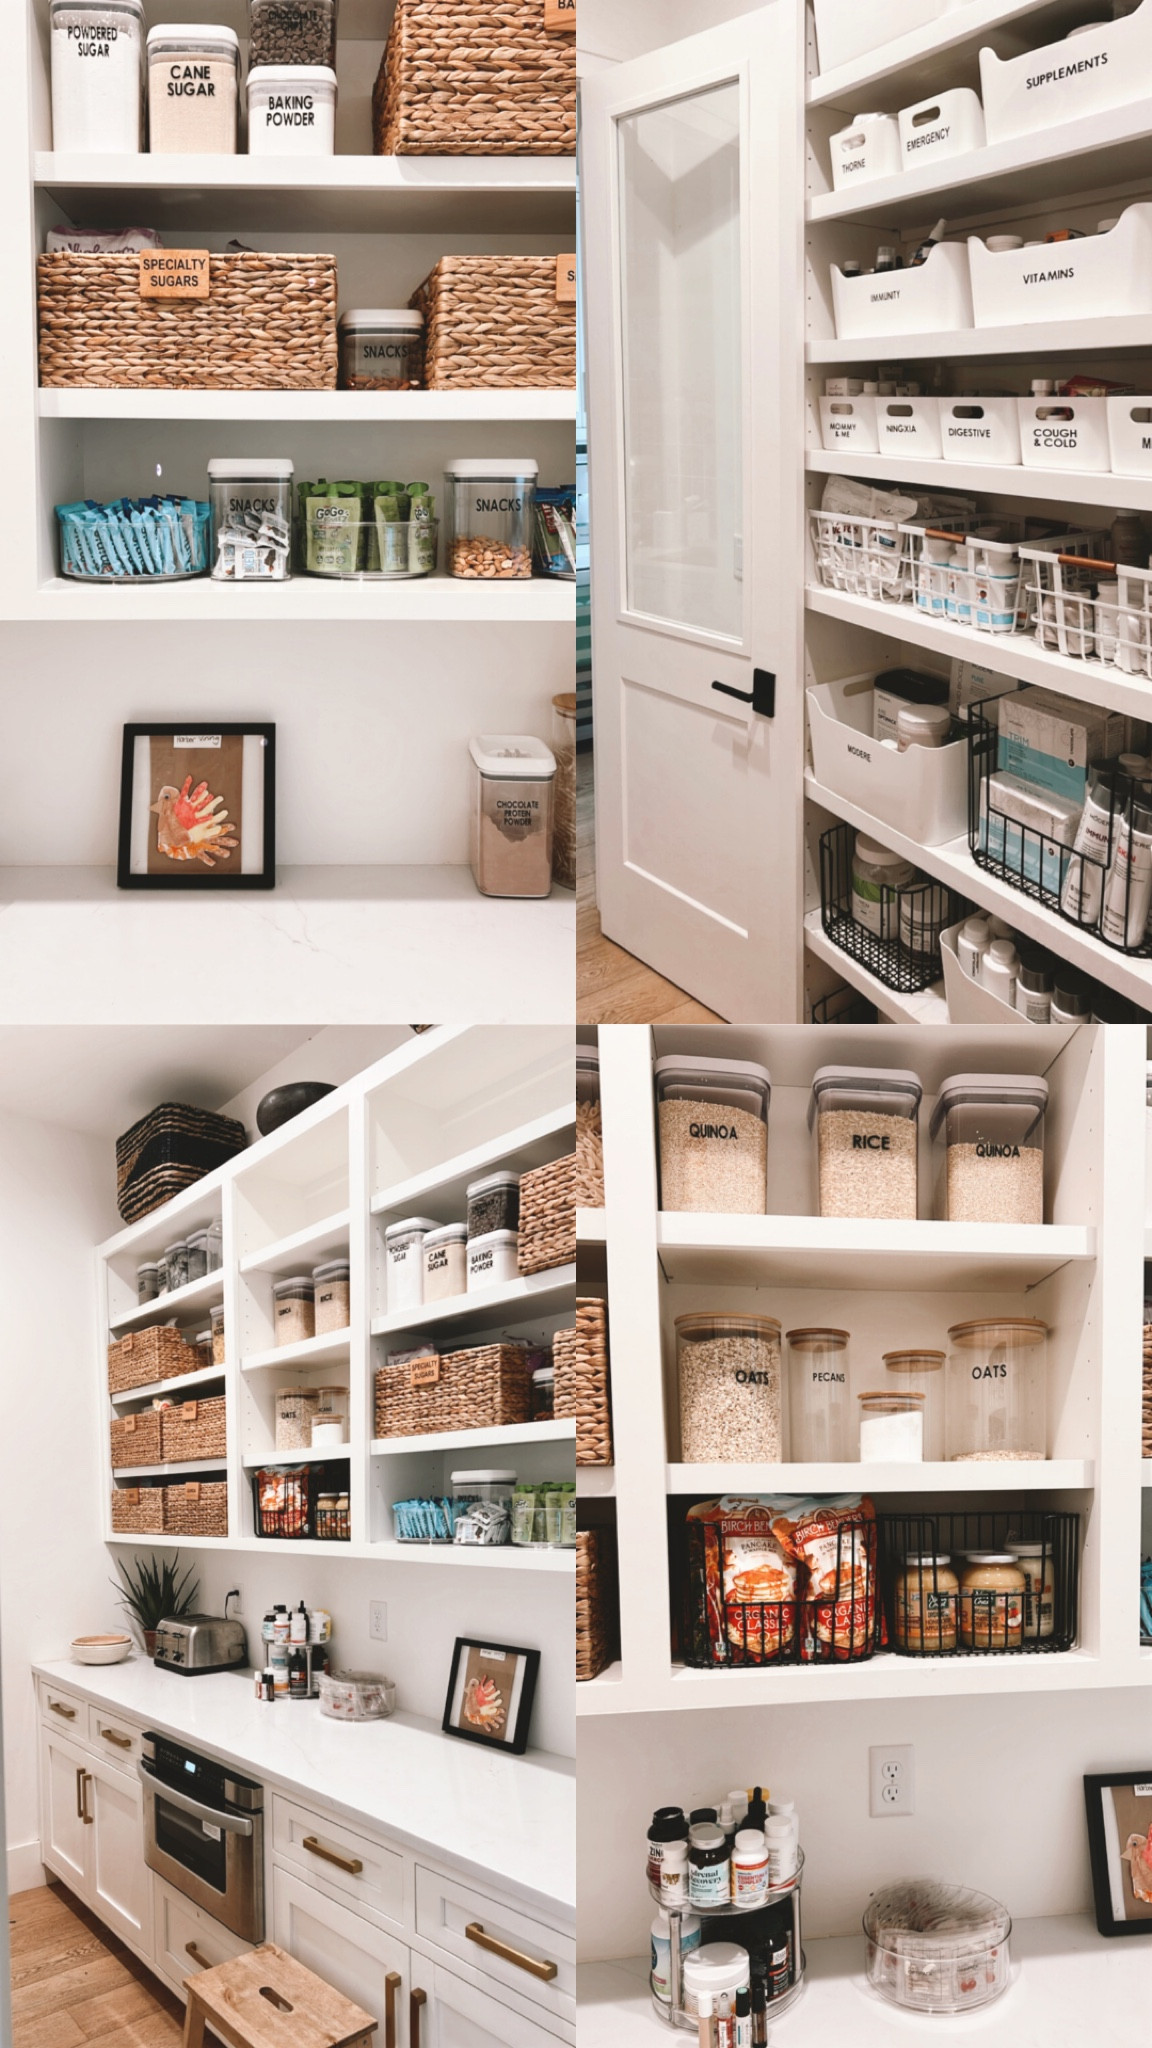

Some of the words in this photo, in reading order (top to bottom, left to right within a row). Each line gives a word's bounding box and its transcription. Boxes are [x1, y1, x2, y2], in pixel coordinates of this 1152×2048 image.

[67, 25, 118, 42] POWDERED
[77, 41, 110, 58] SUGAR
[170, 65, 211, 81] CANE
[1025, 52, 1109, 90] SUPPLEMENTS
[167, 81, 215, 97] SUGAR
[268, 95, 313, 111] BAKING
[266, 110, 315, 127] POWDER
[906, 126, 951, 152] EMERGENCY
[842, 158, 866, 174] THORNE
[143, 258, 206, 271] SPECIALTY
[150, 275, 199, 287] SUGARS
[1022, 267, 1074, 285] VITAMINS
[870, 290, 900, 303] IMMUNITY
[363, 345, 408, 359] SNACKS
[829, 423, 856, 431] MOMMY
[886, 424, 917, 433] NINGXIA
[948, 428, 991, 439] DIGESTIVE
[1033, 428, 1078, 438] COUGH
[1034, 438, 1041, 447] &
[1043, 438, 1077, 448] COLD
[230, 498, 275, 512] SNACKS
[475, 498, 522, 512] SNACKS
[496, 800, 539, 809] CHOCOLATE
[503, 809, 531, 818] PROTEIN
[503, 818, 532, 826] POWDER
[689, 1122, 738, 1141] QUINOA
[852, 1134, 891, 1151] RICE
[975, 1143, 1021, 1160] QUINOA
[428, 1249, 446, 1262] CANE
[471, 1250, 493, 1264] BAKING
[427, 1258, 448, 1272] SUGAR
[470, 1260, 493, 1274] POWDER
[735, 1369, 770, 1386] OATS
[812, 1371, 846, 1384] PECANS
[971, 1364, 1008, 1381] OATS
[721, 1520, 753, 1534] BIRCH
[795, 1523, 825, 1544] BIRCH
[734, 1608, 790, 1620] ORGANC
